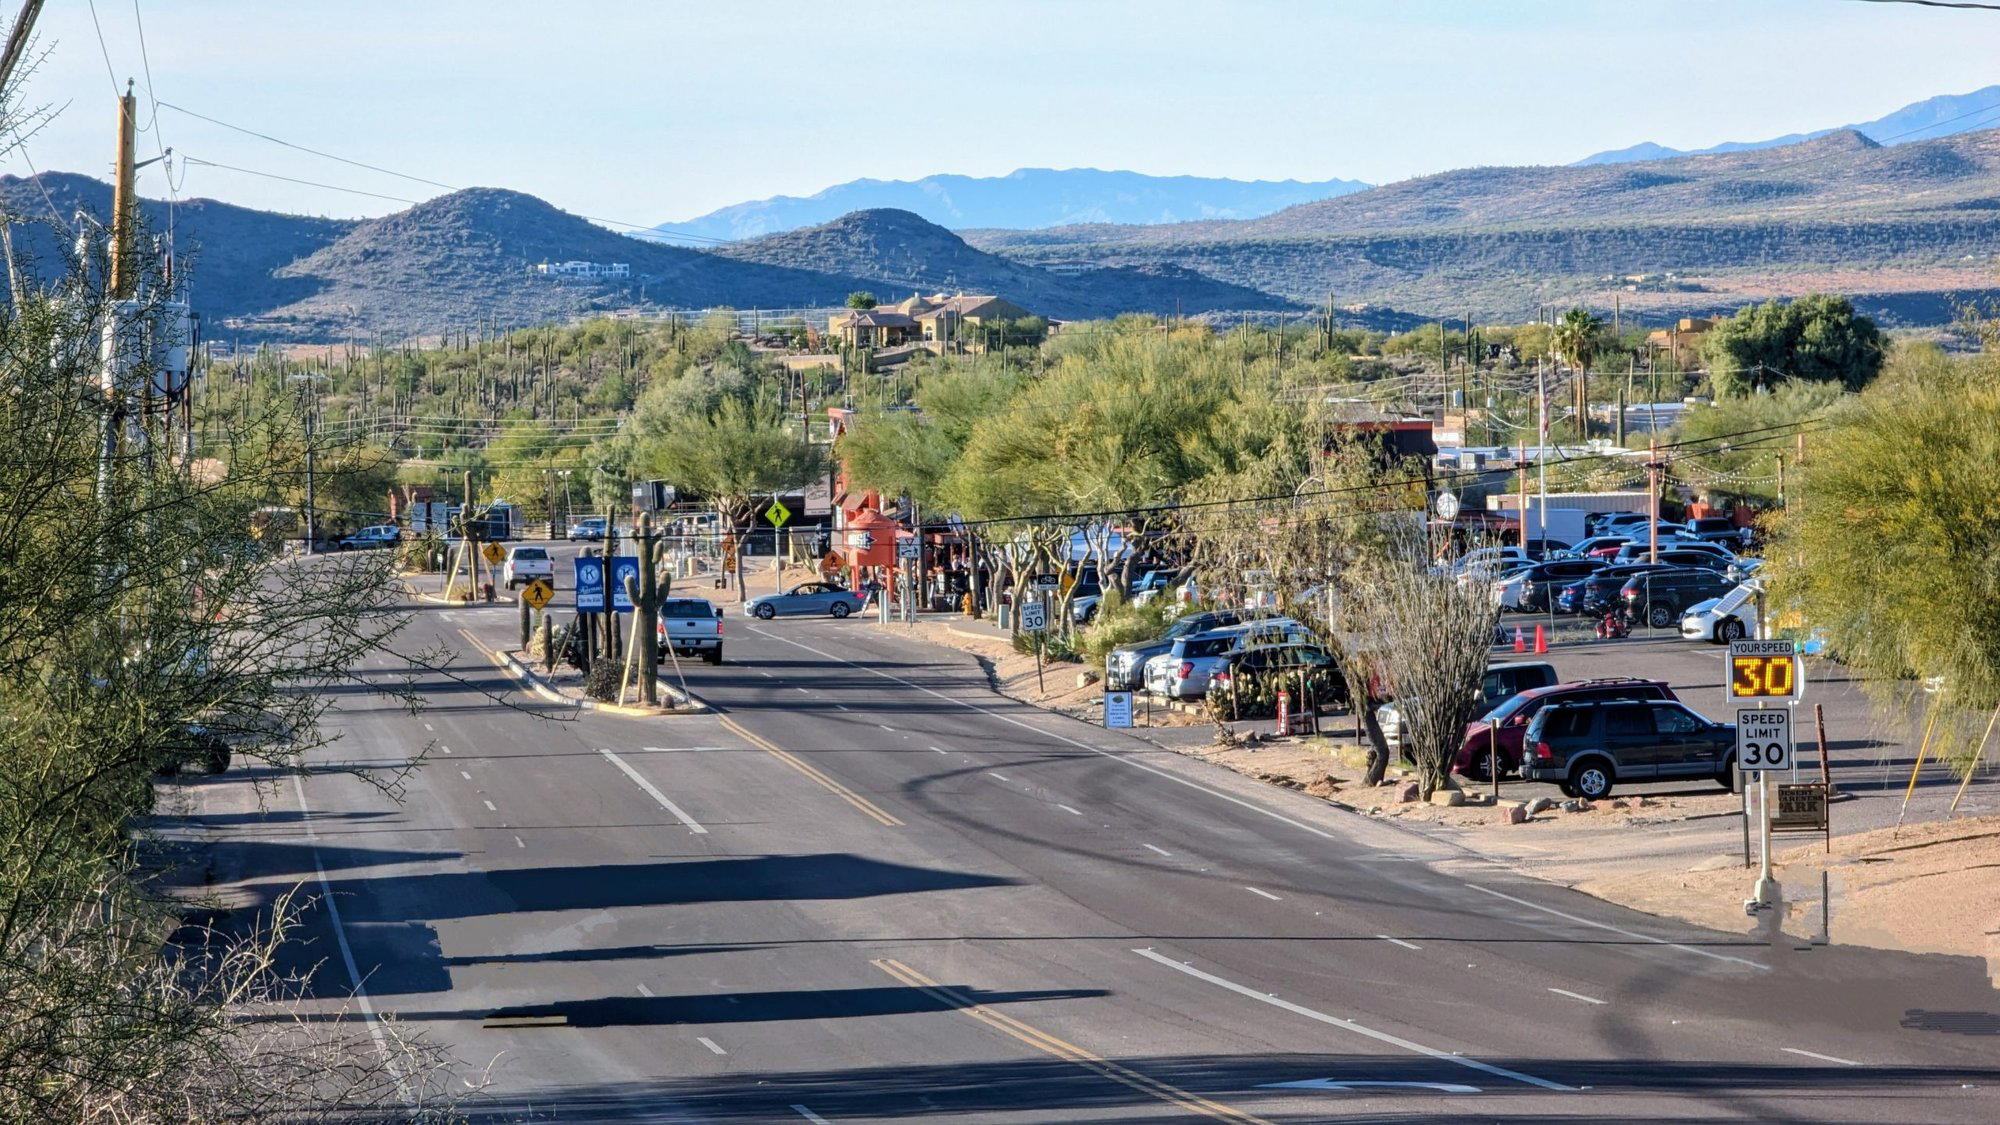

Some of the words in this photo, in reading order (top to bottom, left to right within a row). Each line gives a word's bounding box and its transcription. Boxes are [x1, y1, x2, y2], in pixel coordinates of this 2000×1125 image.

[1025, 616, 1043, 628] 30
[1734, 643, 1760, 653] YOUR
[1761, 642, 1791, 653] SPEED
[1734, 657, 1793, 695] 30
[1742, 714, 1785, 725] SPEED
[1746, 728, 1781, 739] LIMIT
[1744, 742, 1784, 765] 30
